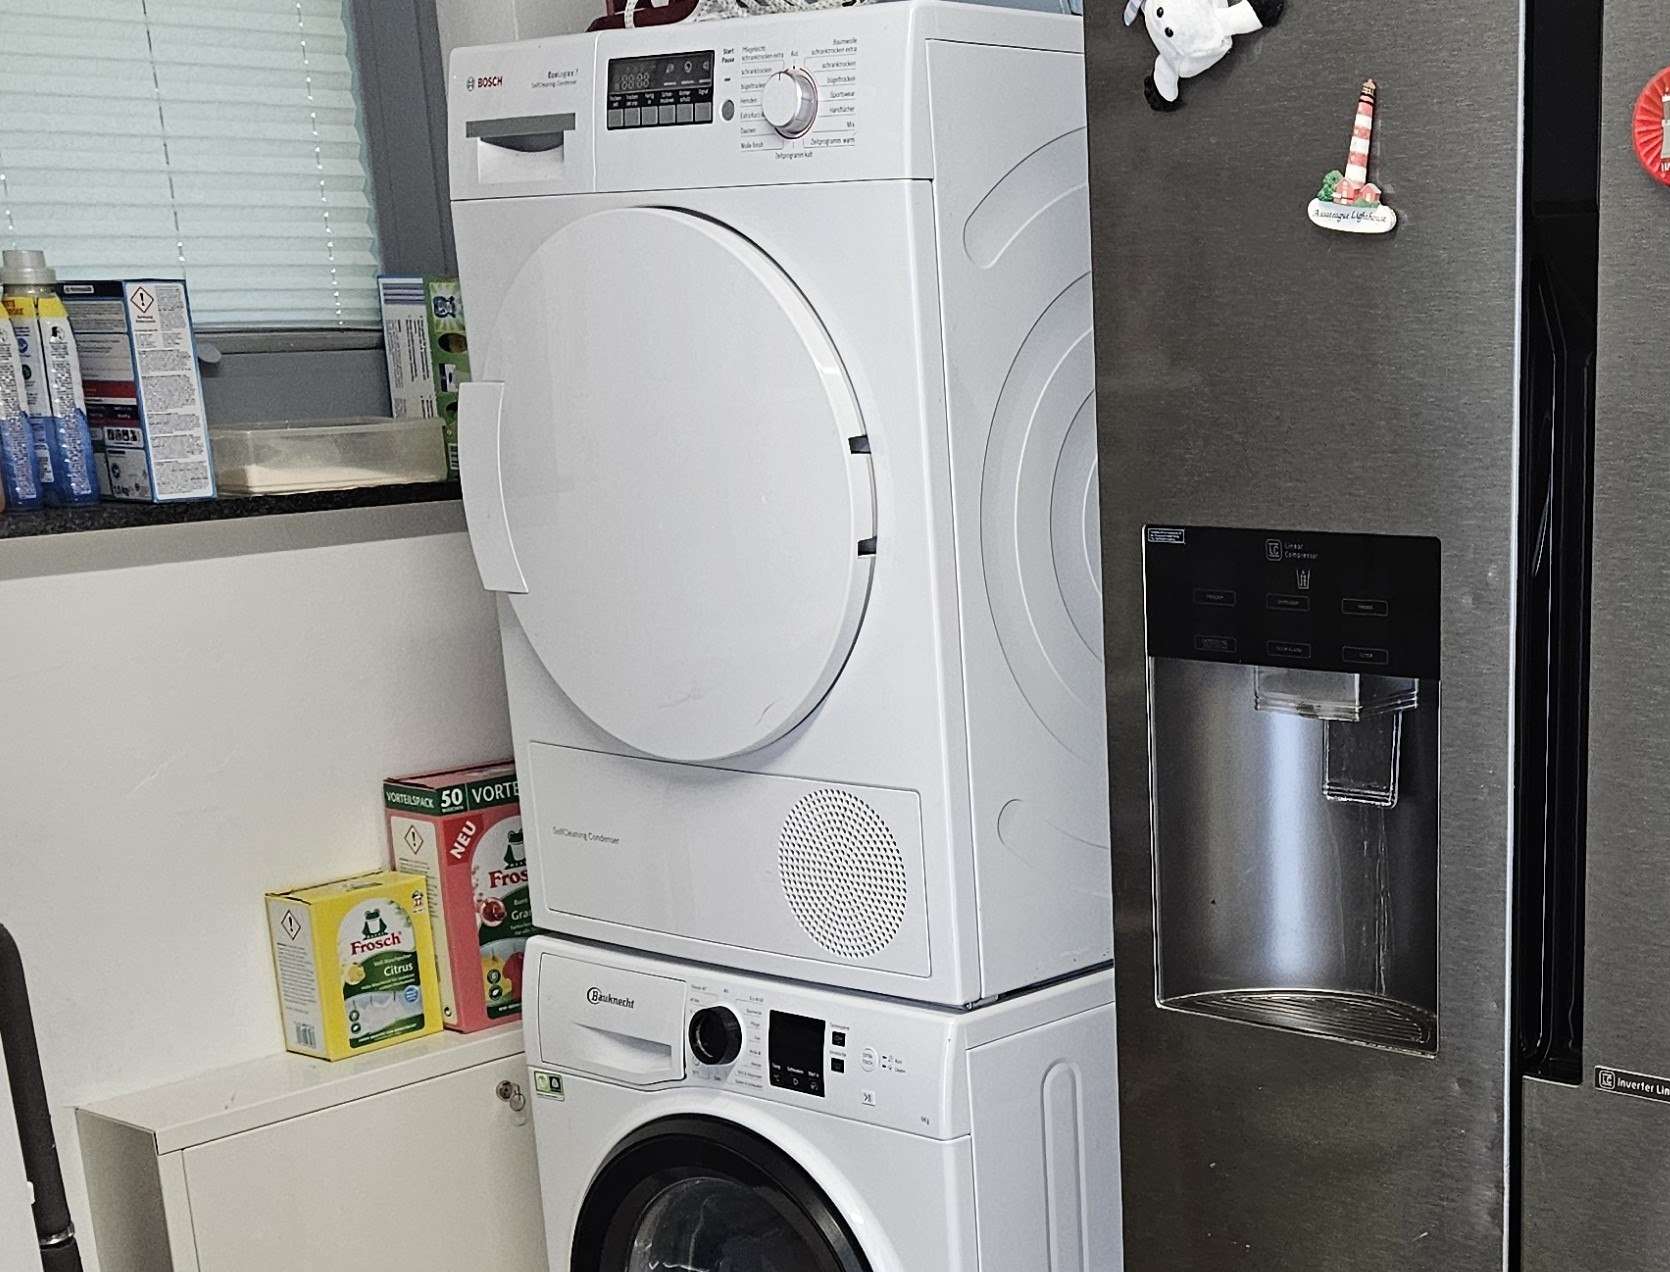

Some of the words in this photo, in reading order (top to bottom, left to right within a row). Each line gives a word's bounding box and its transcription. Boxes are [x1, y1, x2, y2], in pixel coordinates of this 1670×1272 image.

[477, 76, 503, 88] BOSCH
[386, 791, 435, 809] VORTEILSPACK
[441, 788, 464, 808] 50
[449, 820, 477, 860] NEU
[350, 933, 401, 955] Frosch
[384, 962, 414, 977] Citrus
[586, 986, 635, 1009] Bauknecht
[1617, 1077, 1654, 1093] Inverter
